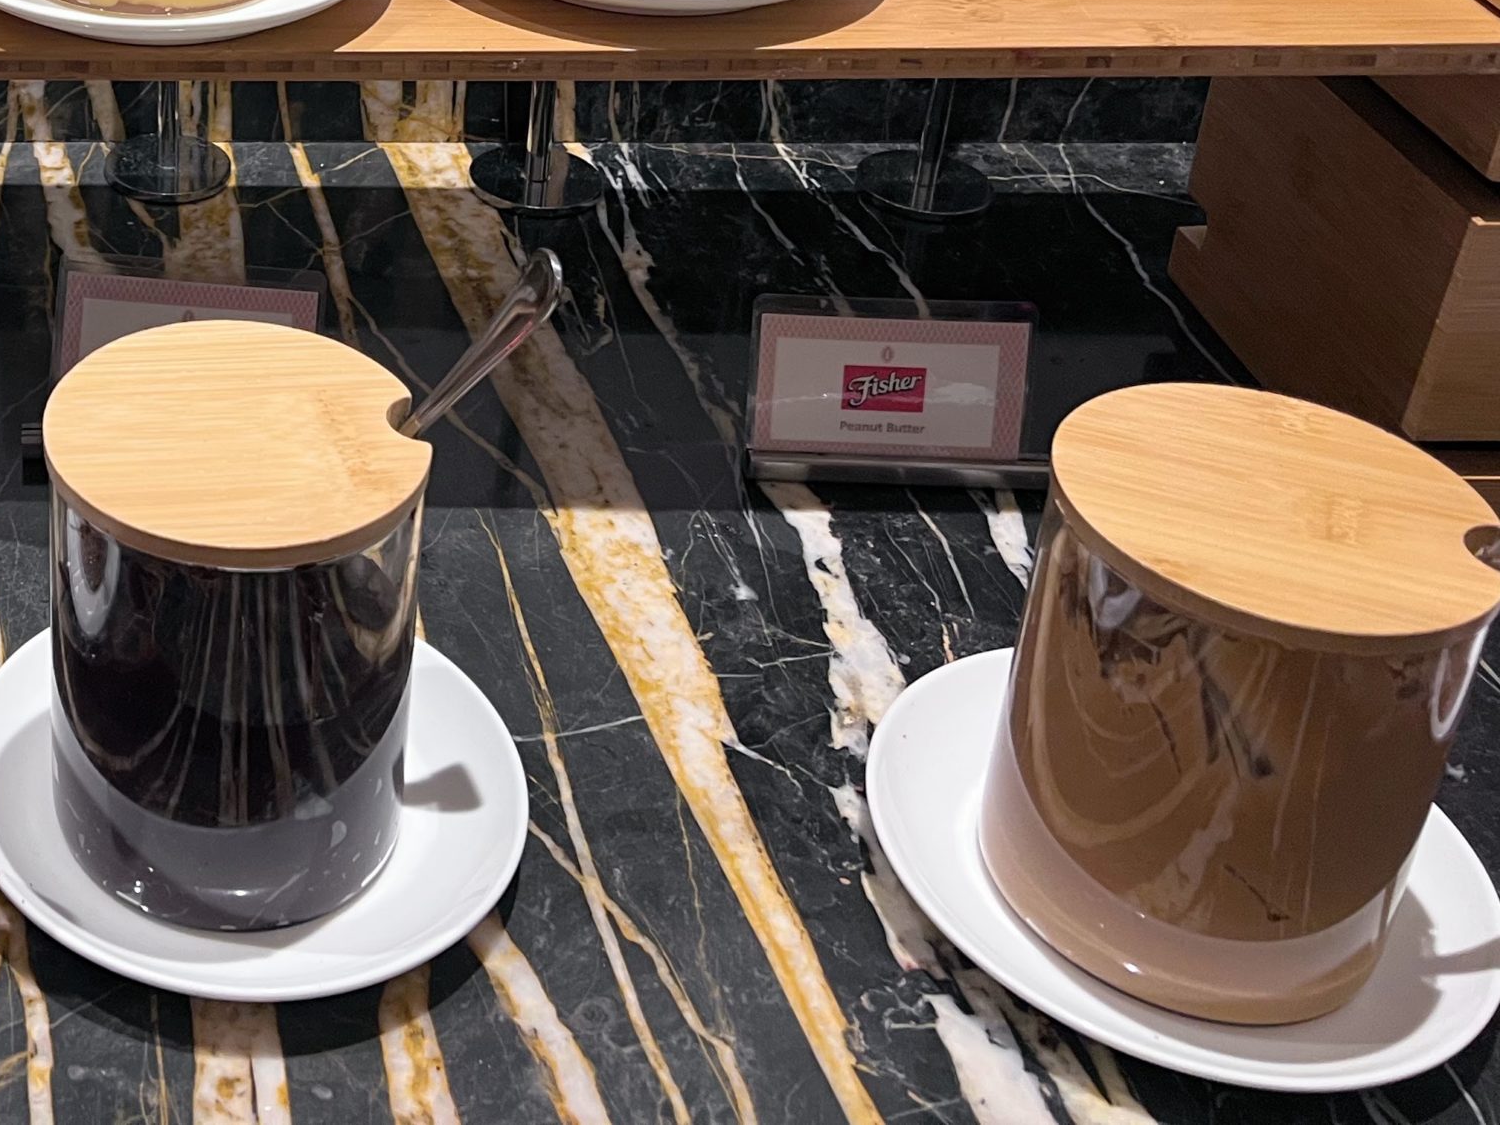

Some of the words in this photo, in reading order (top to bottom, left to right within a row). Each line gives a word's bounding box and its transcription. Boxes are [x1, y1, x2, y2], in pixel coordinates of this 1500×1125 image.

[848, 371, 922, 406] Fisher
[839, 420, 883, 433] Peanut
[886, 422, 925, 434] Butter
